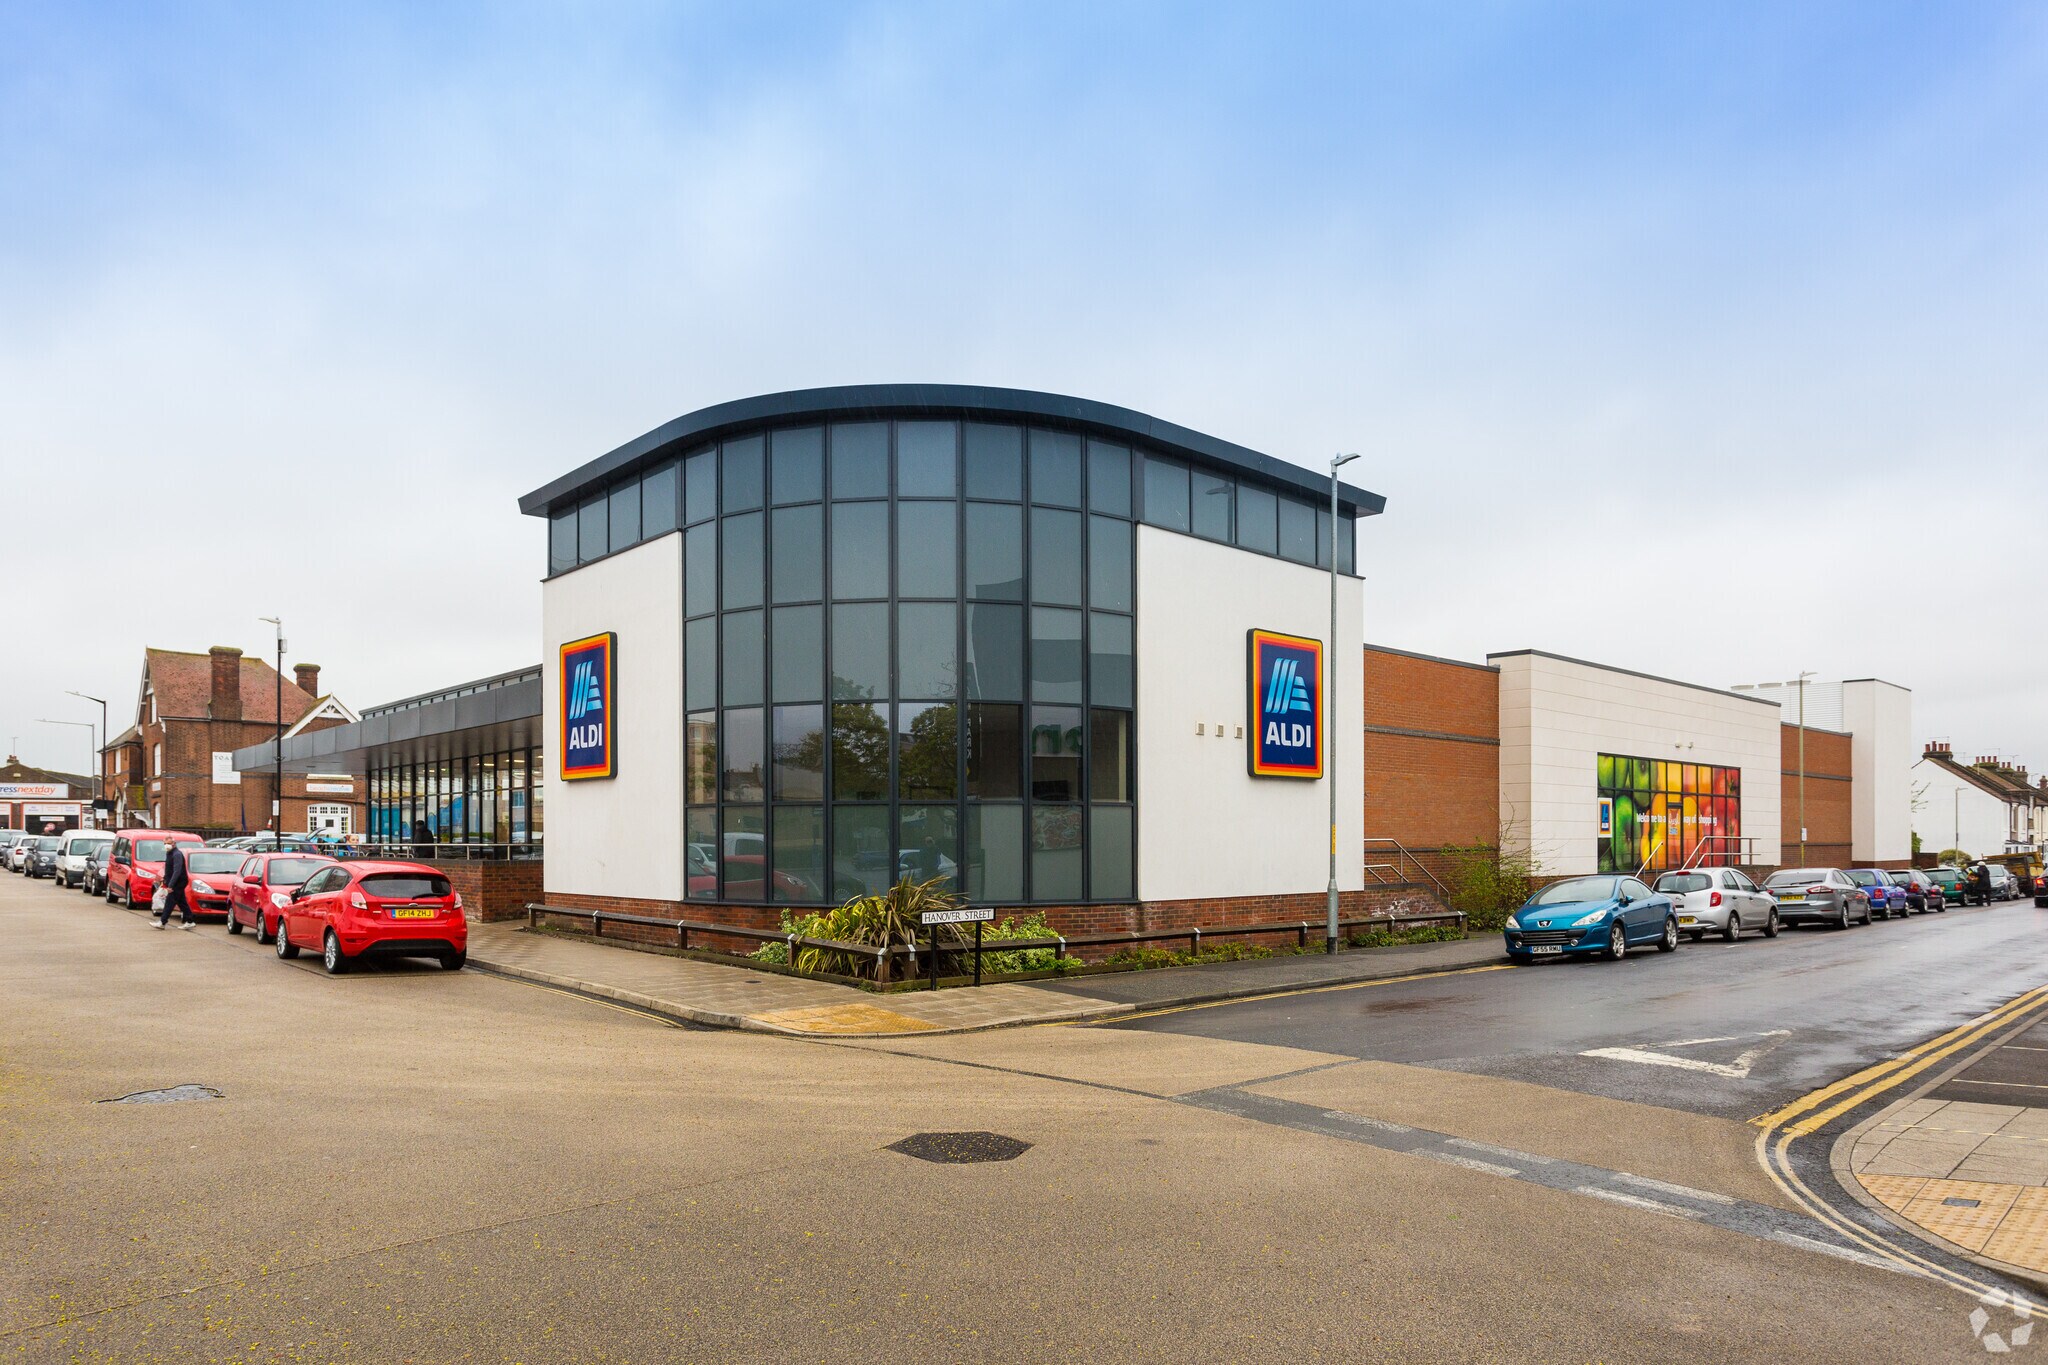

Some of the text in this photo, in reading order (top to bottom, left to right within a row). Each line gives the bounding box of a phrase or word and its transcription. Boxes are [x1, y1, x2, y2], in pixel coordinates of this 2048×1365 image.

[569, 723, 603, 750] ALDI
[1265, 721, 1312, 748] ALDI
[398, 909, 432, 917] GF14 ZHJ
[924, 909, 992, 923] HANOVER STREET
